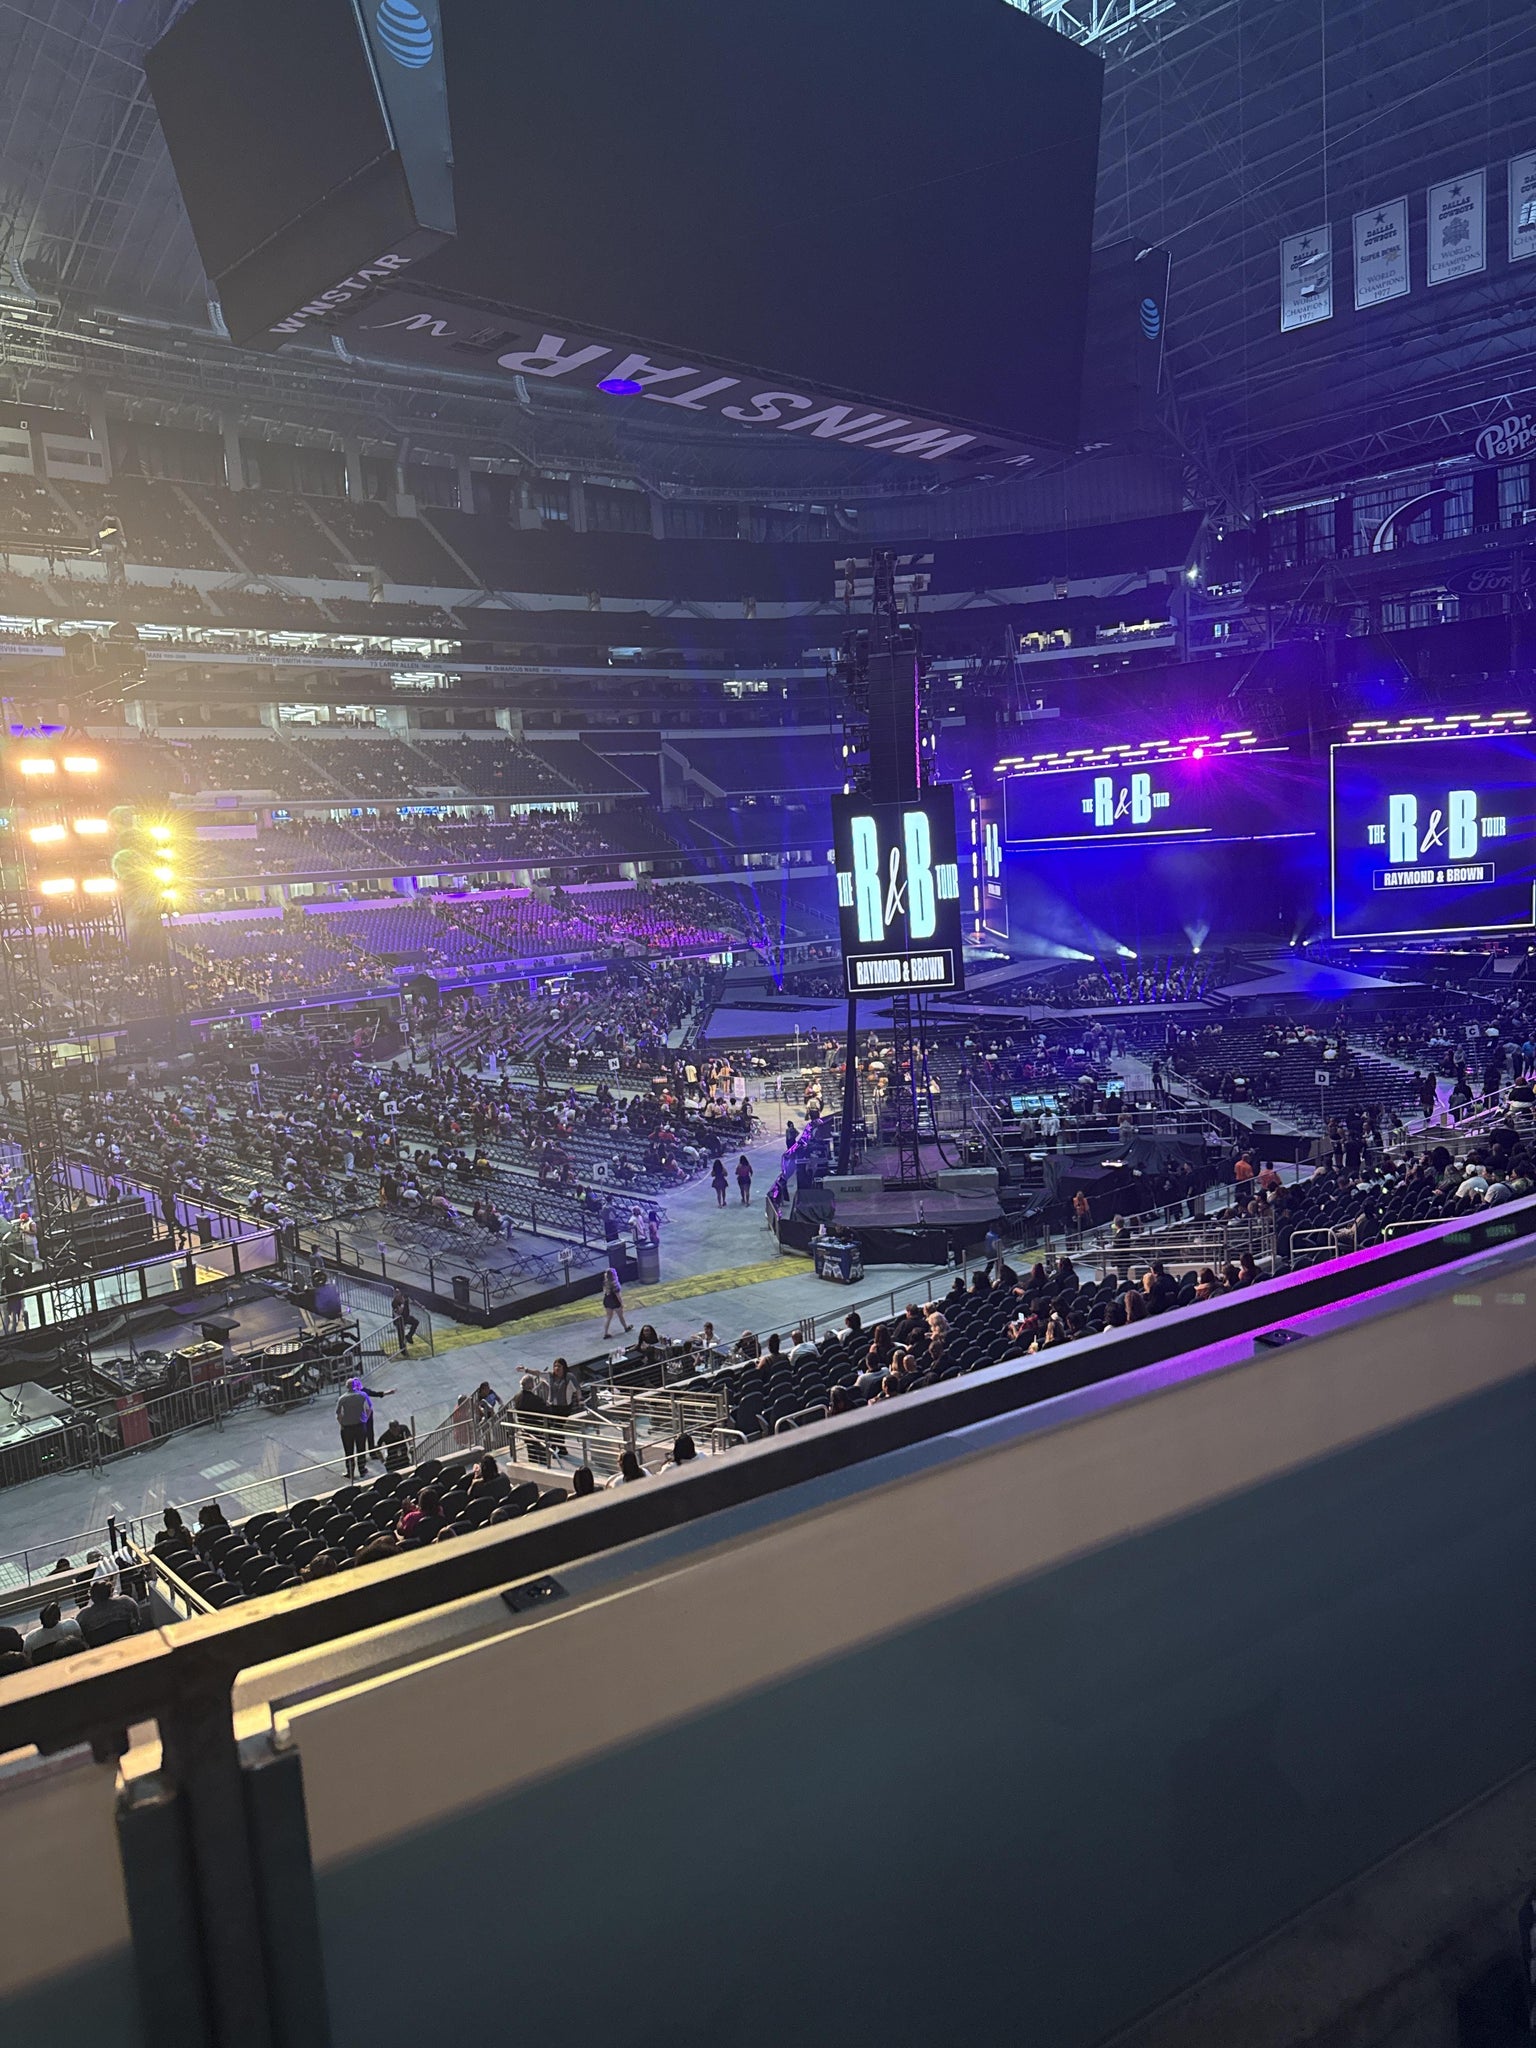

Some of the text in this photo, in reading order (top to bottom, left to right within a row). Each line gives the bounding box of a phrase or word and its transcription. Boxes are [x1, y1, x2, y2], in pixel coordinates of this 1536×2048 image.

[1439, 202, 1475, 221] COWBOYS
[1442, 196, 1471, 211] DALLAS
[1364, 229, 1398, 247] COWBOYS
[1366, 223, 1394, 238] DALLAS
[1293, 248, 1319, 263] DALLAS
[1432, 252, 1481, 271] CHAMPIONS
[1441, 245, 1472, 259] WORLD
[1359, 276, 1405, 294] CHAMPIONS
[1367, 270, 1396, 284] WORLD
[269, 253, 412, 335] WINSTAR
[1374, 287, 1391, 299] 1977
[497, 334, 977, 460] WINSTAR
[1502, 414, 1532, 438] Dr
[1475, 425, 1536, 460] Peppe
[1094, 773, 1152, 827] R&B
[1367, 790, 1507, 863] THE R&B TOUR
[837, 811, 959, 943] THE R&B TOUR
[1384, 866, 1484, 887] RAYMOND & BROWN
[856, 956, 945, 985] RAYMOND & BROWN
[1317, 1074, 1326, 1082] D
[386, 1104, 394, 1112] R
